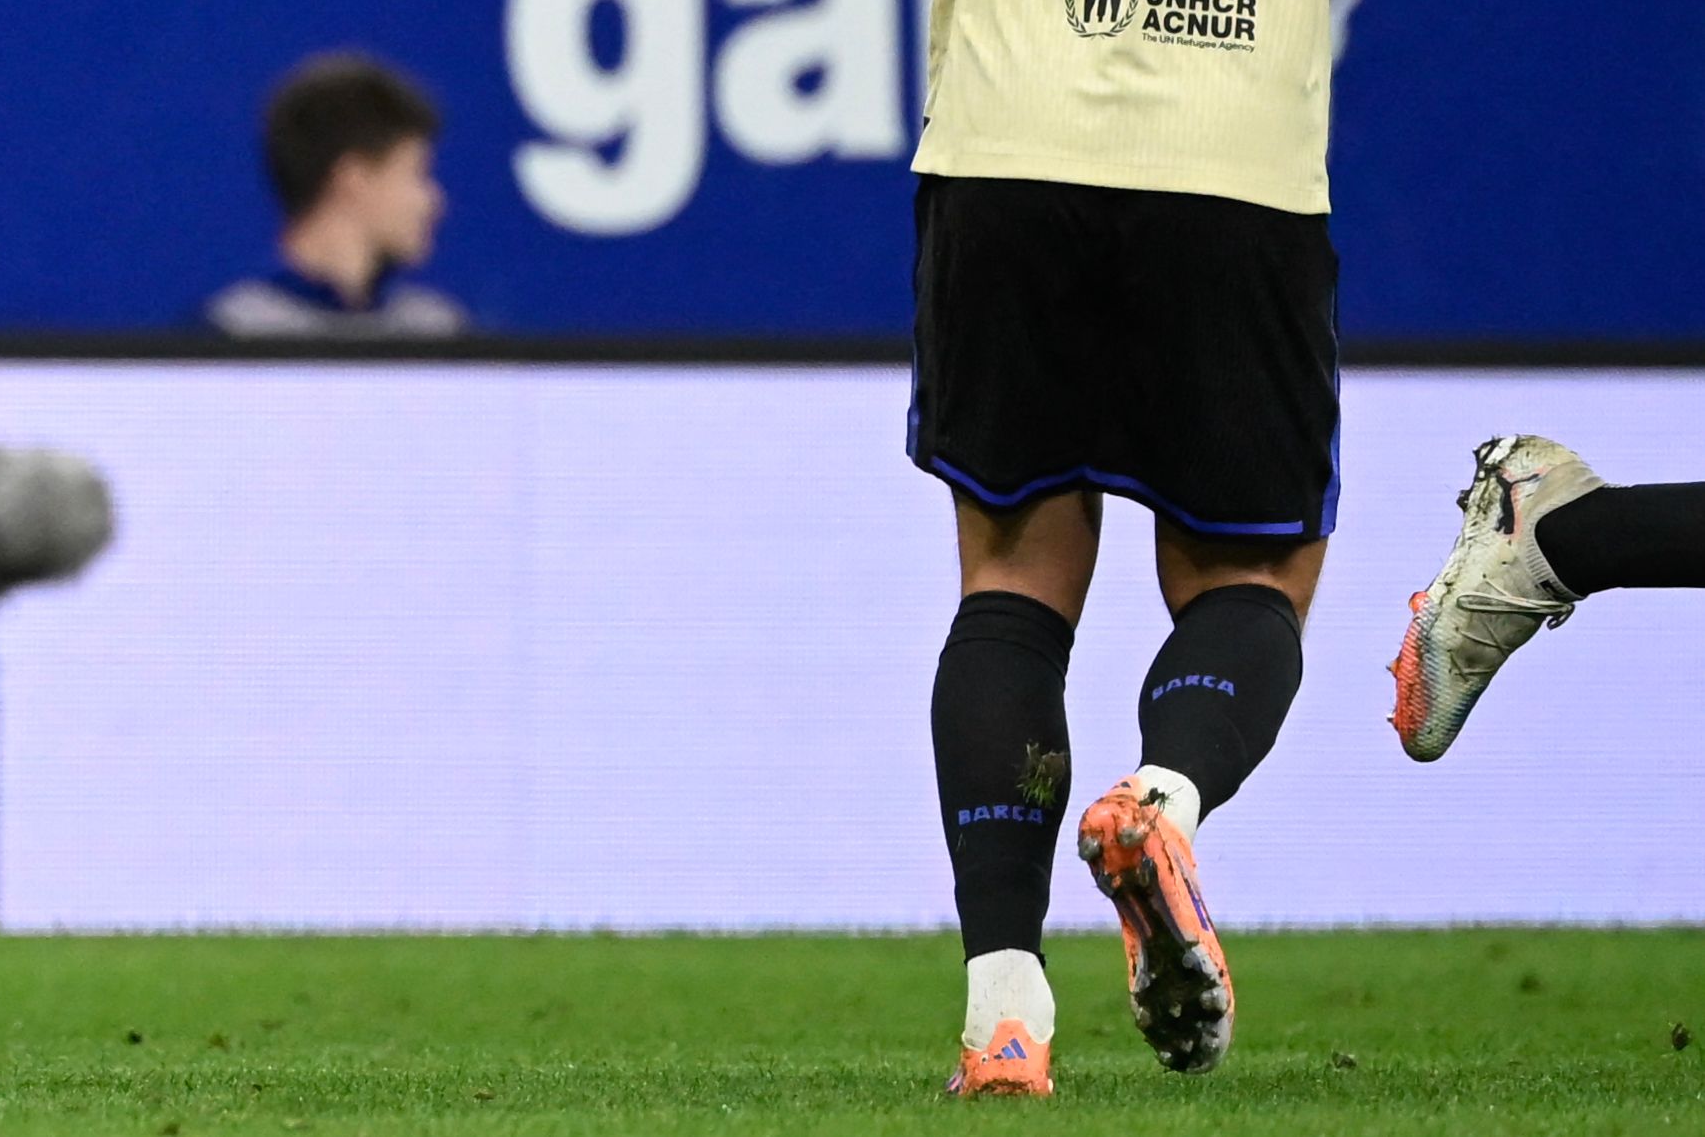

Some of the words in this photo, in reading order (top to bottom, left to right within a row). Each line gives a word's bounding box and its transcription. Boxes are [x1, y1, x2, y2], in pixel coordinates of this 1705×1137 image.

[1142, 8, 1255, 41] ACNUR
[1142, 32, 1157, 43] The
[1159, 35, 1174, 45] UN
[1176, 37, 1217, 49] Refugee
[1218, 41, 1255, 53] Agency
